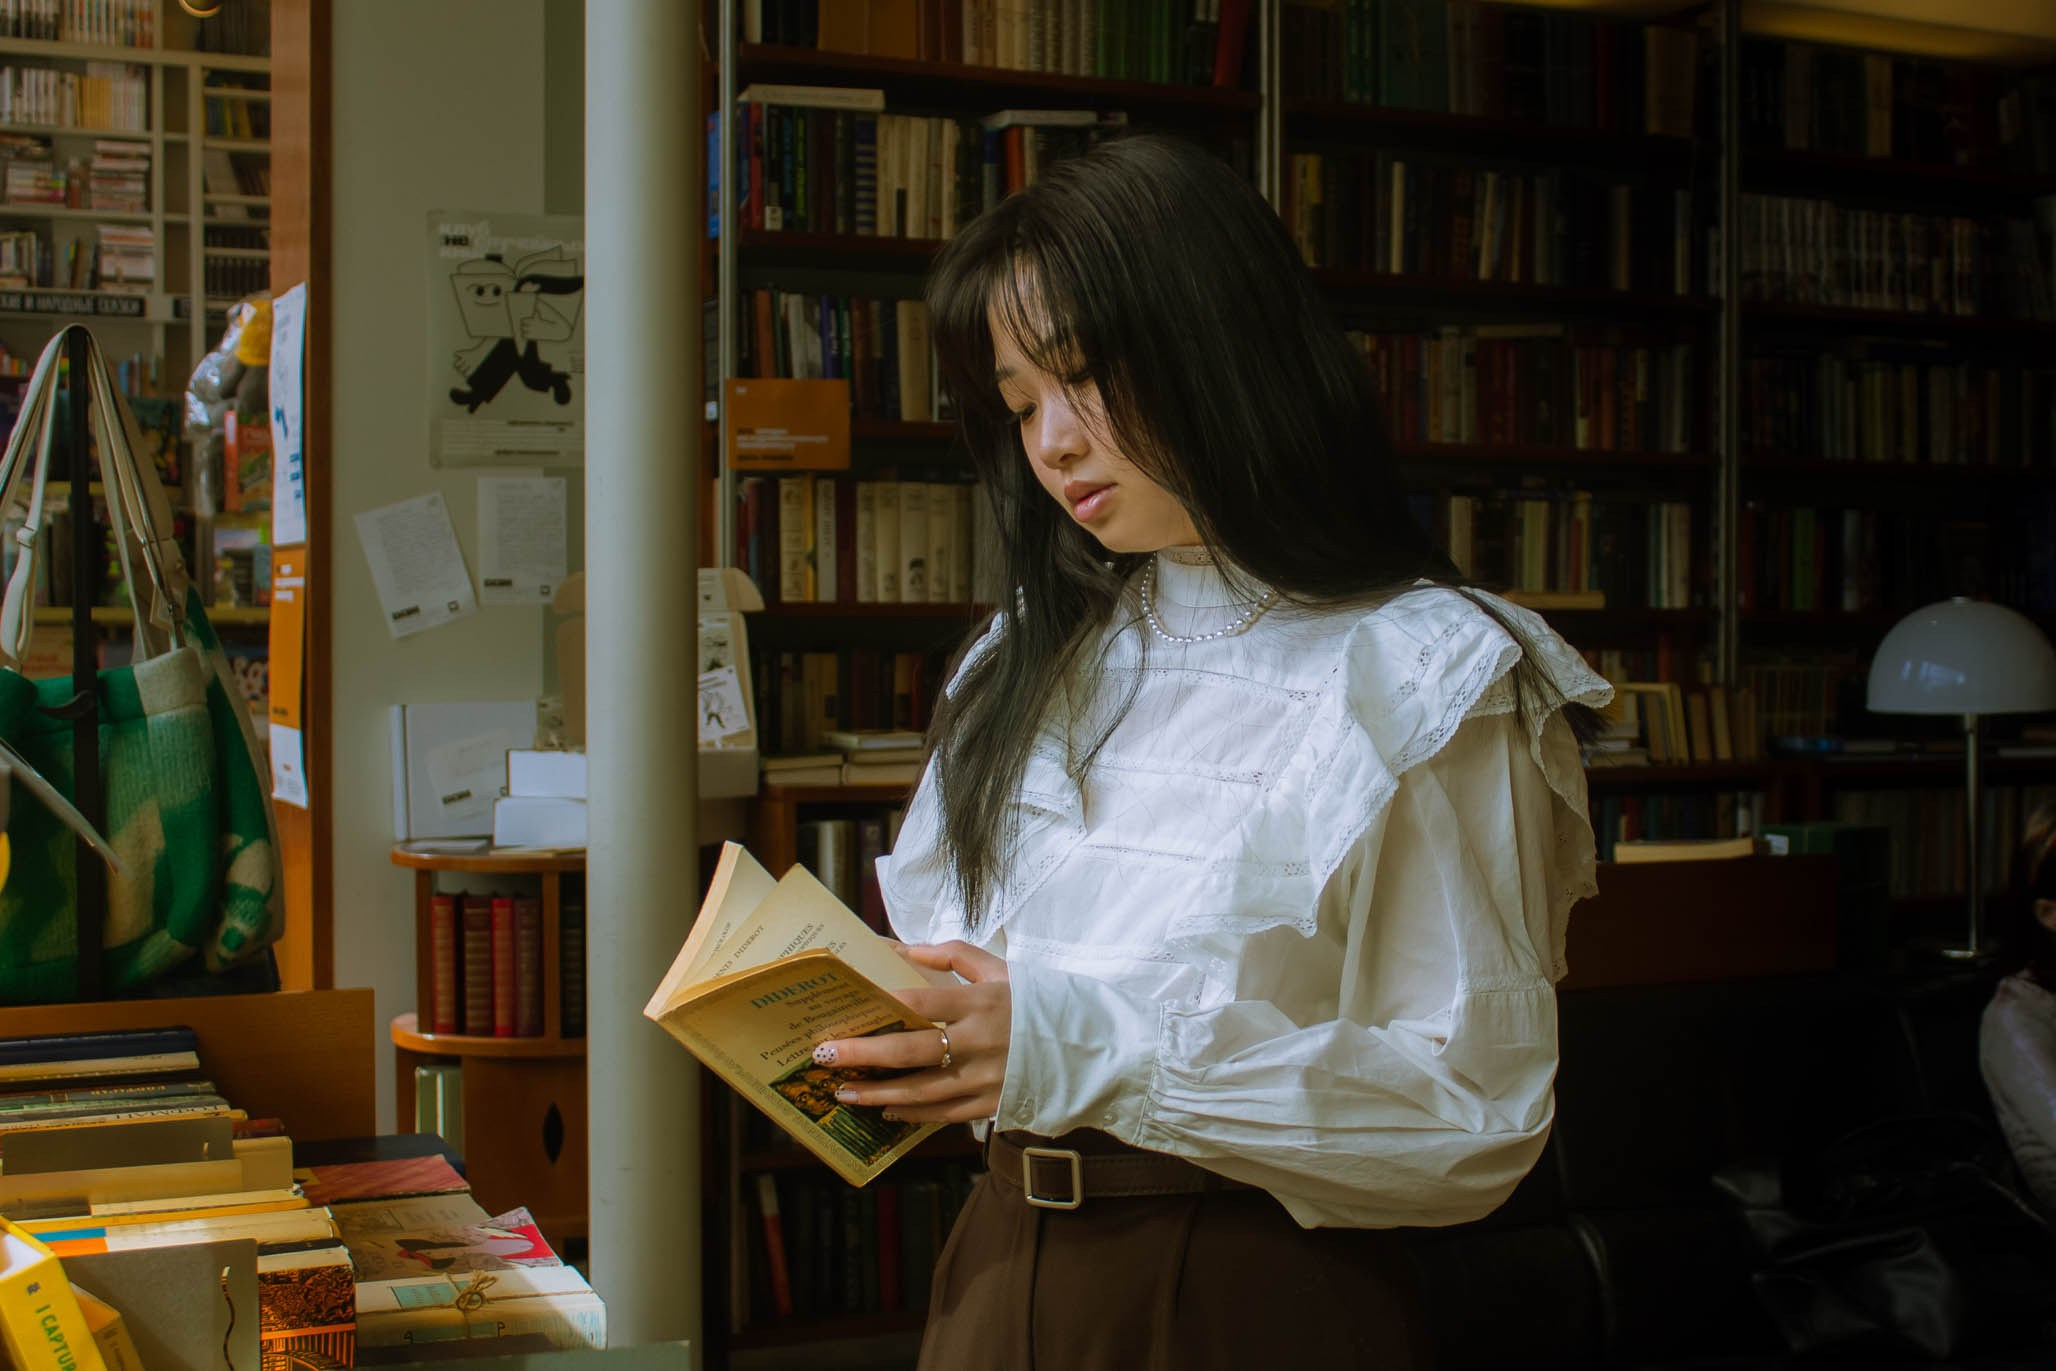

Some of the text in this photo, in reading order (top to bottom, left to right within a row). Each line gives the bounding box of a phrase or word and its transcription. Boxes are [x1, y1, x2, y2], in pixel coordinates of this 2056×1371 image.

[734, 924, 765, 959] DIDEROT
[751, 972, 838, 1008] DIDEROT
[788, 1020, 802, 1031] de
[776, 1046, 810, 1067] Lettre
[35, 1304, 51, 1314] I
